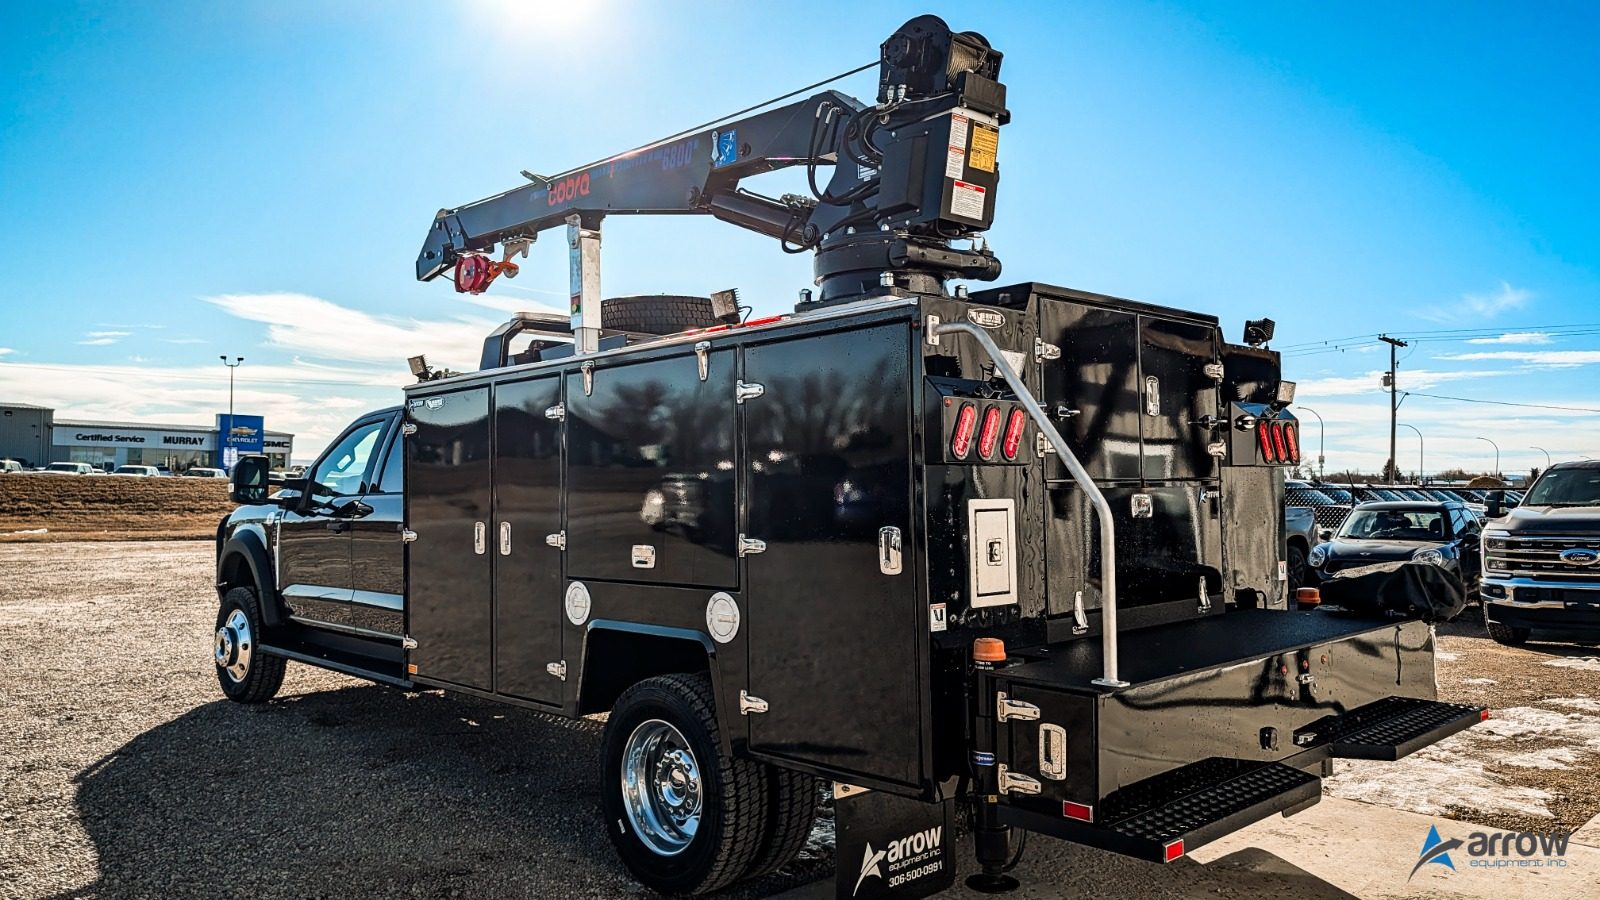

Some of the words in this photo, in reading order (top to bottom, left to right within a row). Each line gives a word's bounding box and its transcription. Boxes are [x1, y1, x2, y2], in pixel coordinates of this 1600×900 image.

[76, 433, 113, 442] Certified
[115, 435, 145, 443] Service
[163, 436, 205, 446] MURRAY
[1571, 553, 1589, 561] Ford
[887, 826, 941, 862] arrow
[889, 853, 929, 871] equipment
[889, 861, 942, 887] 306-500-0991
